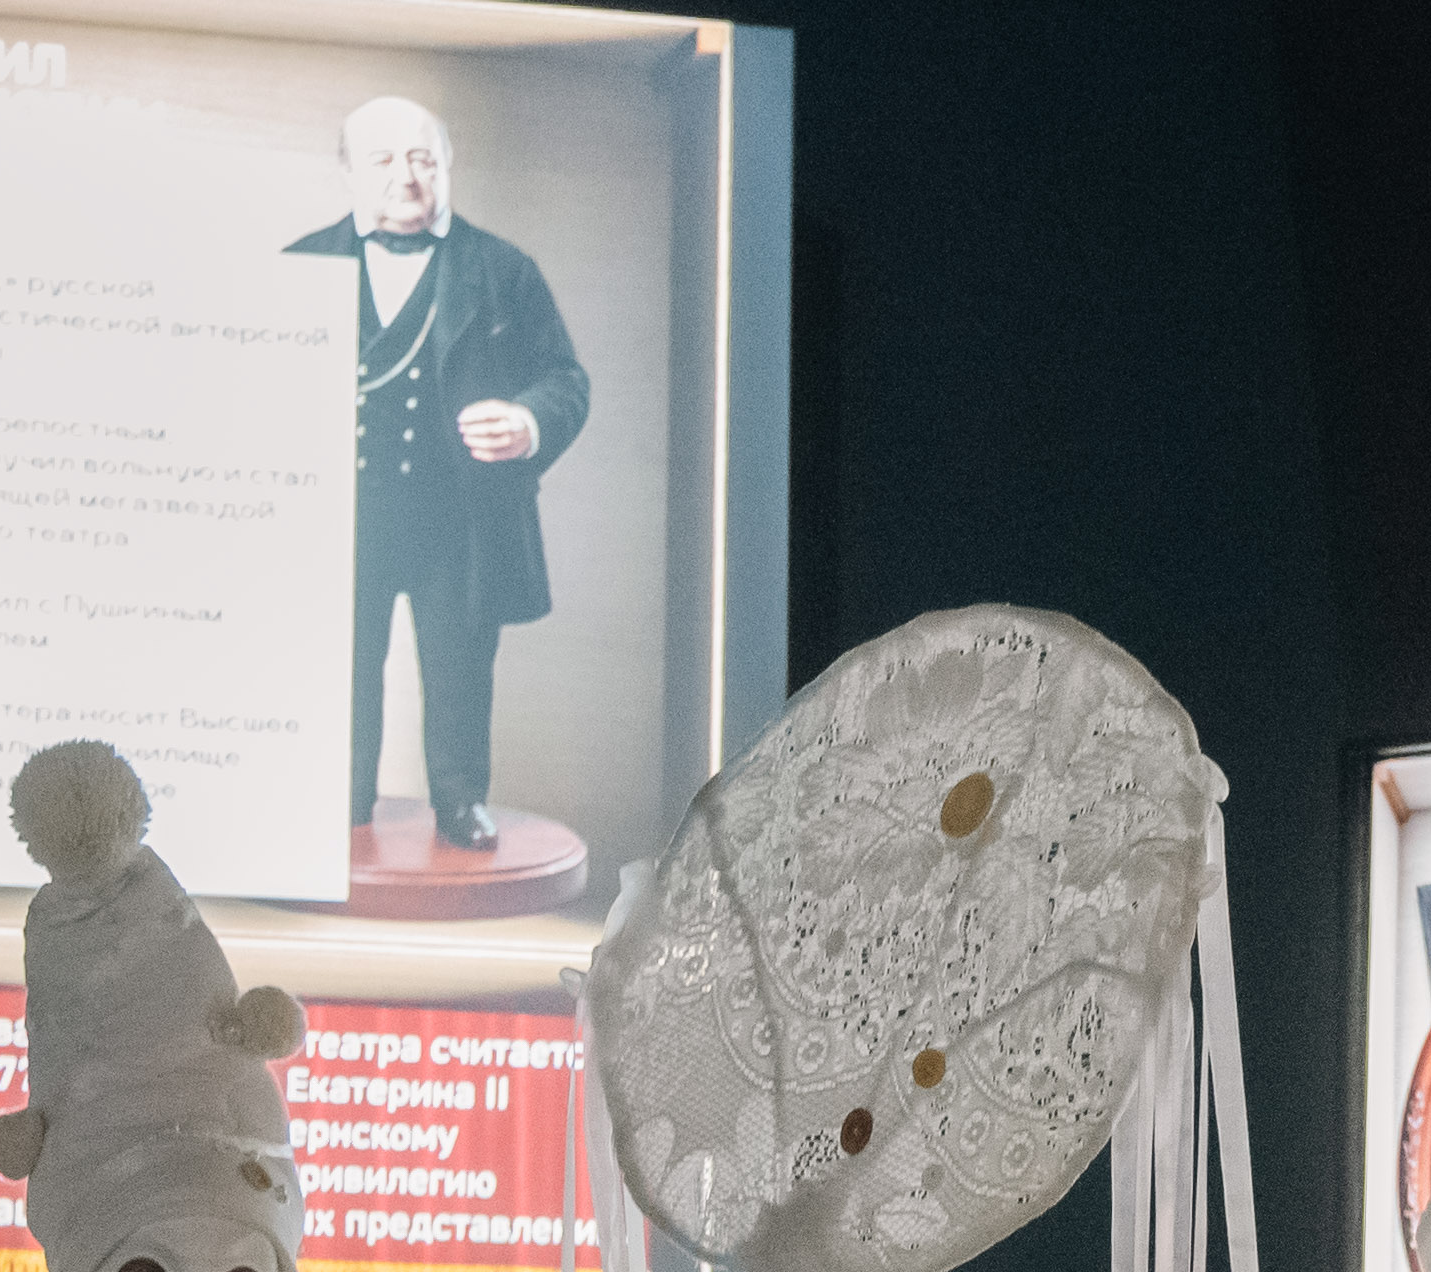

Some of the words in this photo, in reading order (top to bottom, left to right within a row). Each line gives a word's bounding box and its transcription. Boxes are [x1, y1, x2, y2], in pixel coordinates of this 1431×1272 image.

[27, 276, 156, 299] русской
[171, 319, 331, 347] актерской
[83, 458, 216, 483] вольную
[223, 467, 242, 482] и
[249, 467, 319, 488] стал
[78, 493, 276, 521] мегазвездой
[26, 525, 130, 548] театра
[39, 597, 53, 614] с
[63, 593, 224, 622] Пушкиным
[79, 706, 169, 728] носит
[179, 706, 300, 735] Высшее
[430, 1035, 584, 1071] считаетс
[286, 1065, 475, 1114] Екатерина
[485, 1074, 509, 1111] II
[289, 1117, 459, 1161] ернскому
[300, 1163, 497, 1199] ривилегию
